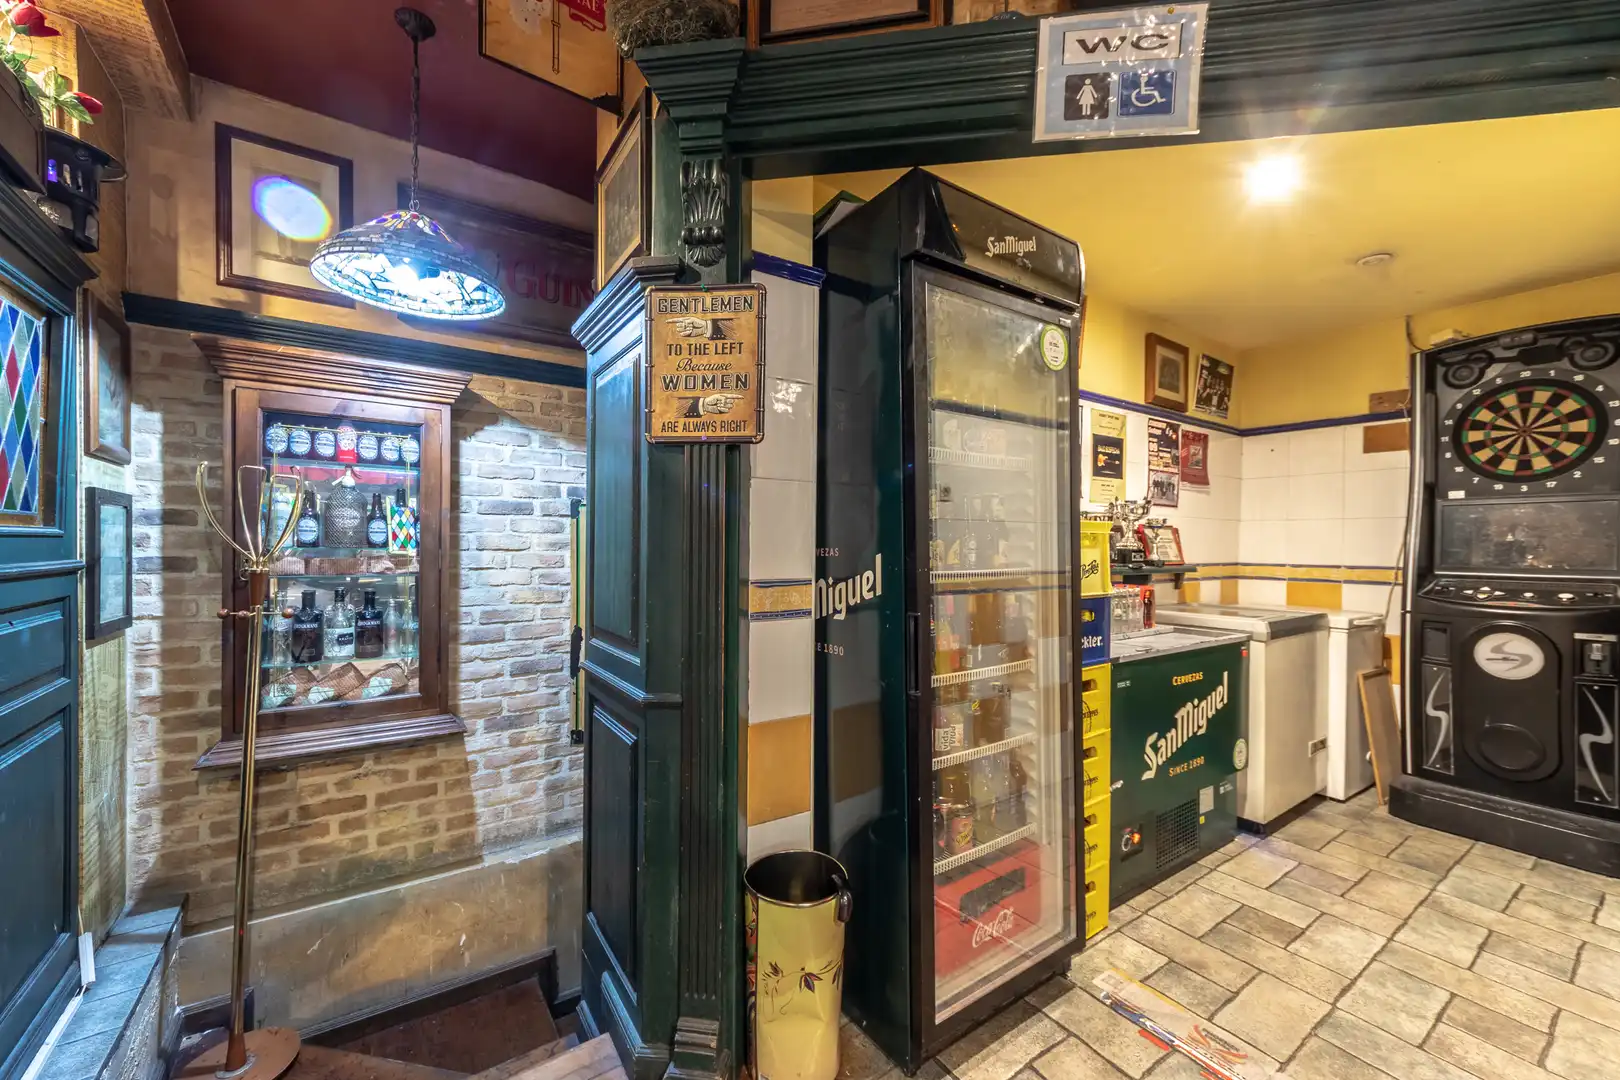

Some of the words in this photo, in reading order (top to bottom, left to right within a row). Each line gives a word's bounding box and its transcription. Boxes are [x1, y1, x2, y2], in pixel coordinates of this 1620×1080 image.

[1076, 34, 1168, 54] WC
[985, 236, 1037, 257] SanMiguel
[657, 295, 754, 314] GENTLEMEN
[667, 344, 682, 356] TO
[687, 343, 709, 356] THE
[714, 342, 743, 355] LEFT
[676, 357, 732, 372] Because
[1520, 370, 1531, 378] 20
[661, 372, 750, 391] WOMEN
[1595, 384, 1604, 392] 4
[661, 420, 678, 433] ARE
[682, 420, 717, 433] ALWAYS
[720, 419, 747, 432] RIGHT
[1593, 456, 1605, 464] 15
[1573, 470, 1582, 478] 2
[824, 644, 844, 655] 1890
[1172, 672, 1203, 686] CERVEZAS
[1141, 671, 1228, 780] SanMiguel
[1169, 762, 1188, 777] SINCE
[1190, 756, 1205, 770] 1890
